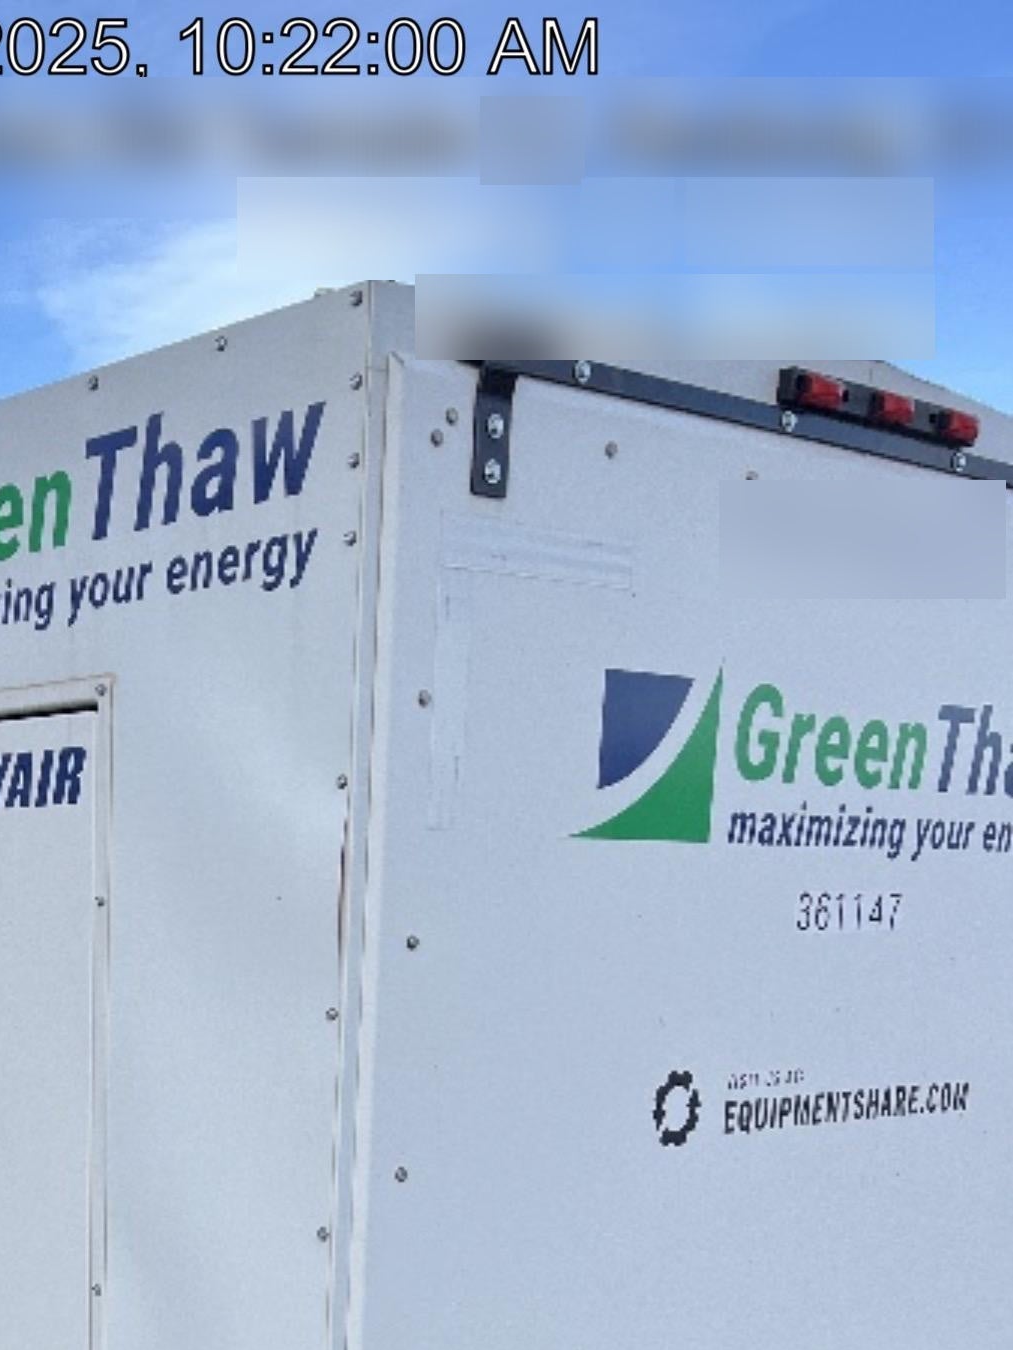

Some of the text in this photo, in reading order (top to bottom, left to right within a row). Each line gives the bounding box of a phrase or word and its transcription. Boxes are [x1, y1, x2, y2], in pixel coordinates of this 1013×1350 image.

[67, 561, 153, 627] your
[166, 528, 319, 595] energy
[728, 801, 906, 859] maximizing
[911, 818, 975, 861] your
[796, 891, 902, 931] 361147
[724, 1081, 970, 1135] EQUIPMENTSHARE.COM
